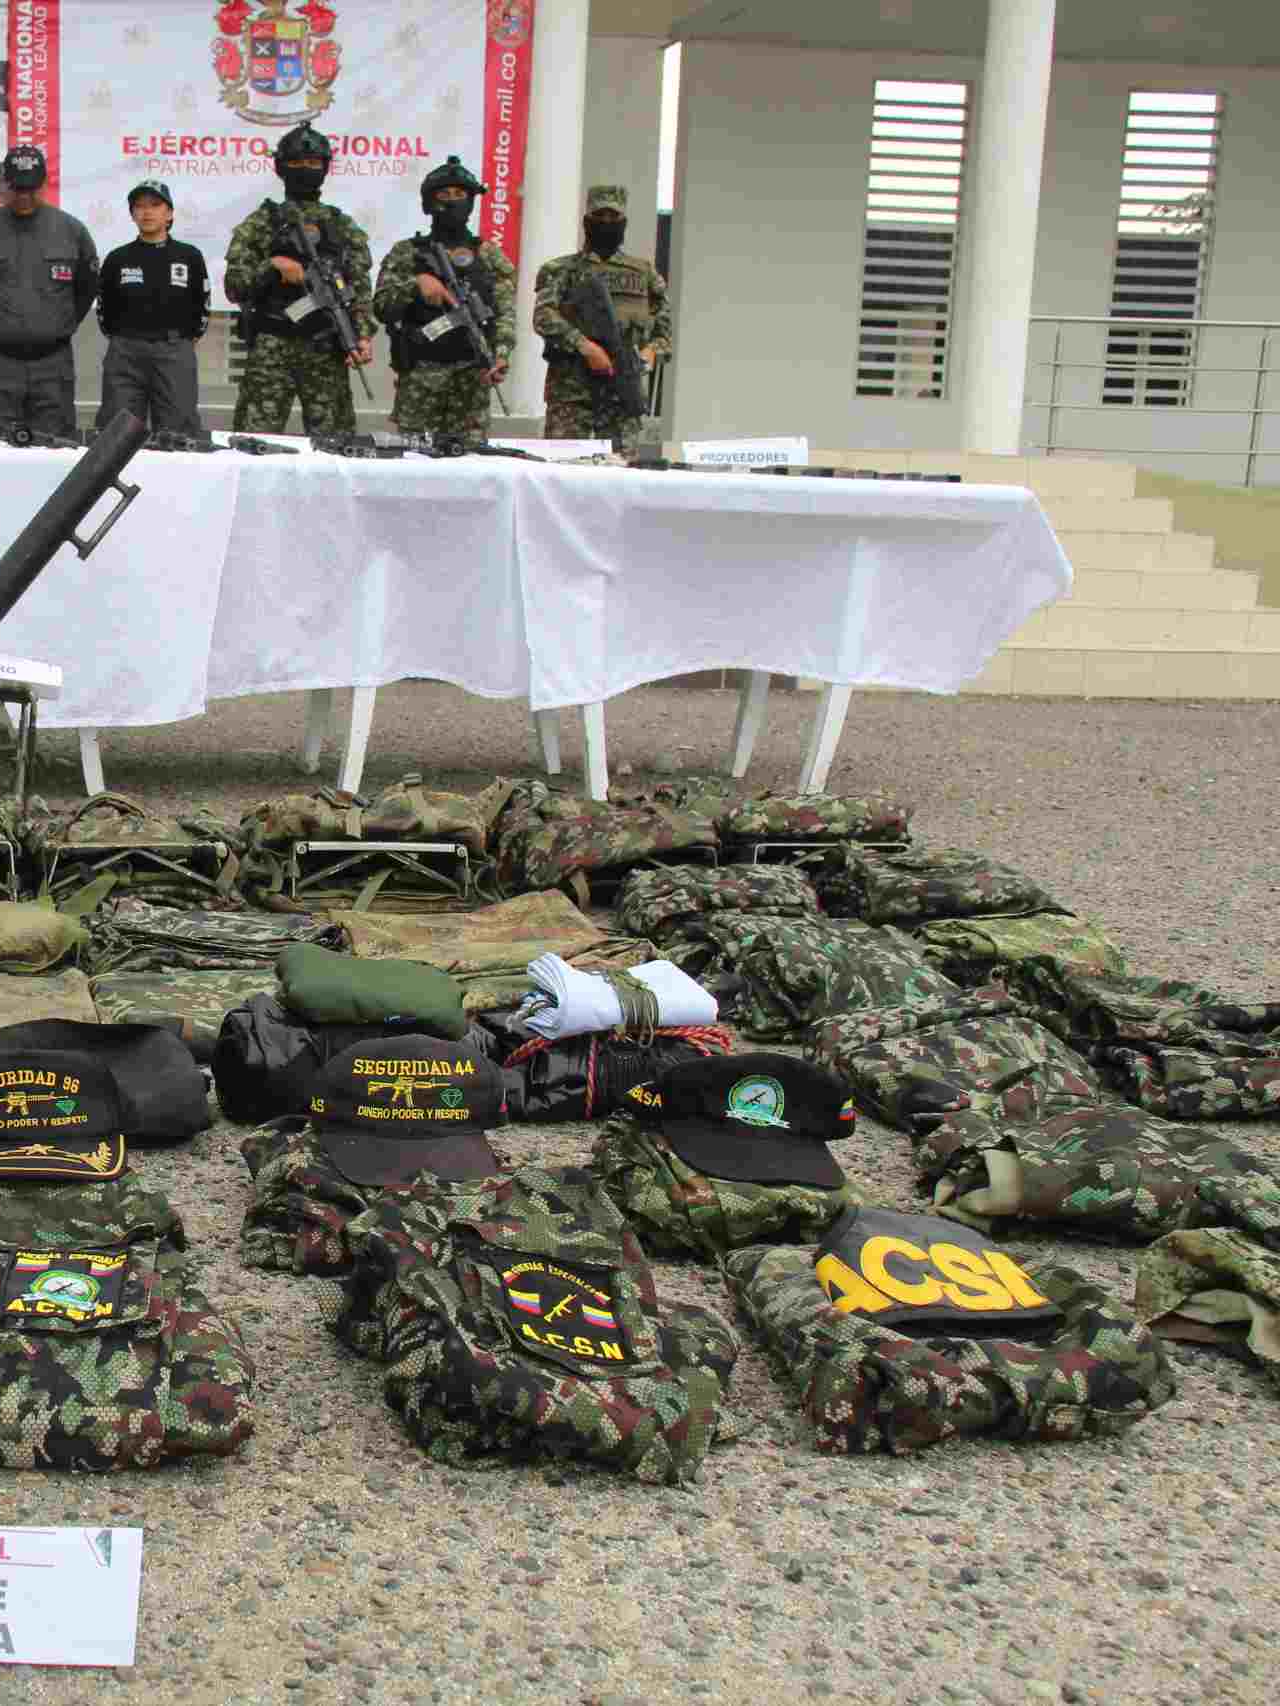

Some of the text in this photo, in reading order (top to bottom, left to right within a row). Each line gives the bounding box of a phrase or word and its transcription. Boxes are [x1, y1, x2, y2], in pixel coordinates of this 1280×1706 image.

[16, 0, 33, 100] NACIONA
[122, 130, 430, 157] EJÉRCITO CIONAL
[144, 159, 408, 176] PATRIA HON EALTAD
[699, 452, 789, 463] PROVEEDORES
[352, 1058, 476, 1076] SEGURIDAD 44
[357, 1106, 469, 1120] DINERO PODER Y RESPETO
[7, 1118, 39, 1129] PODER
[42, 1118, 49, 1127] Y
